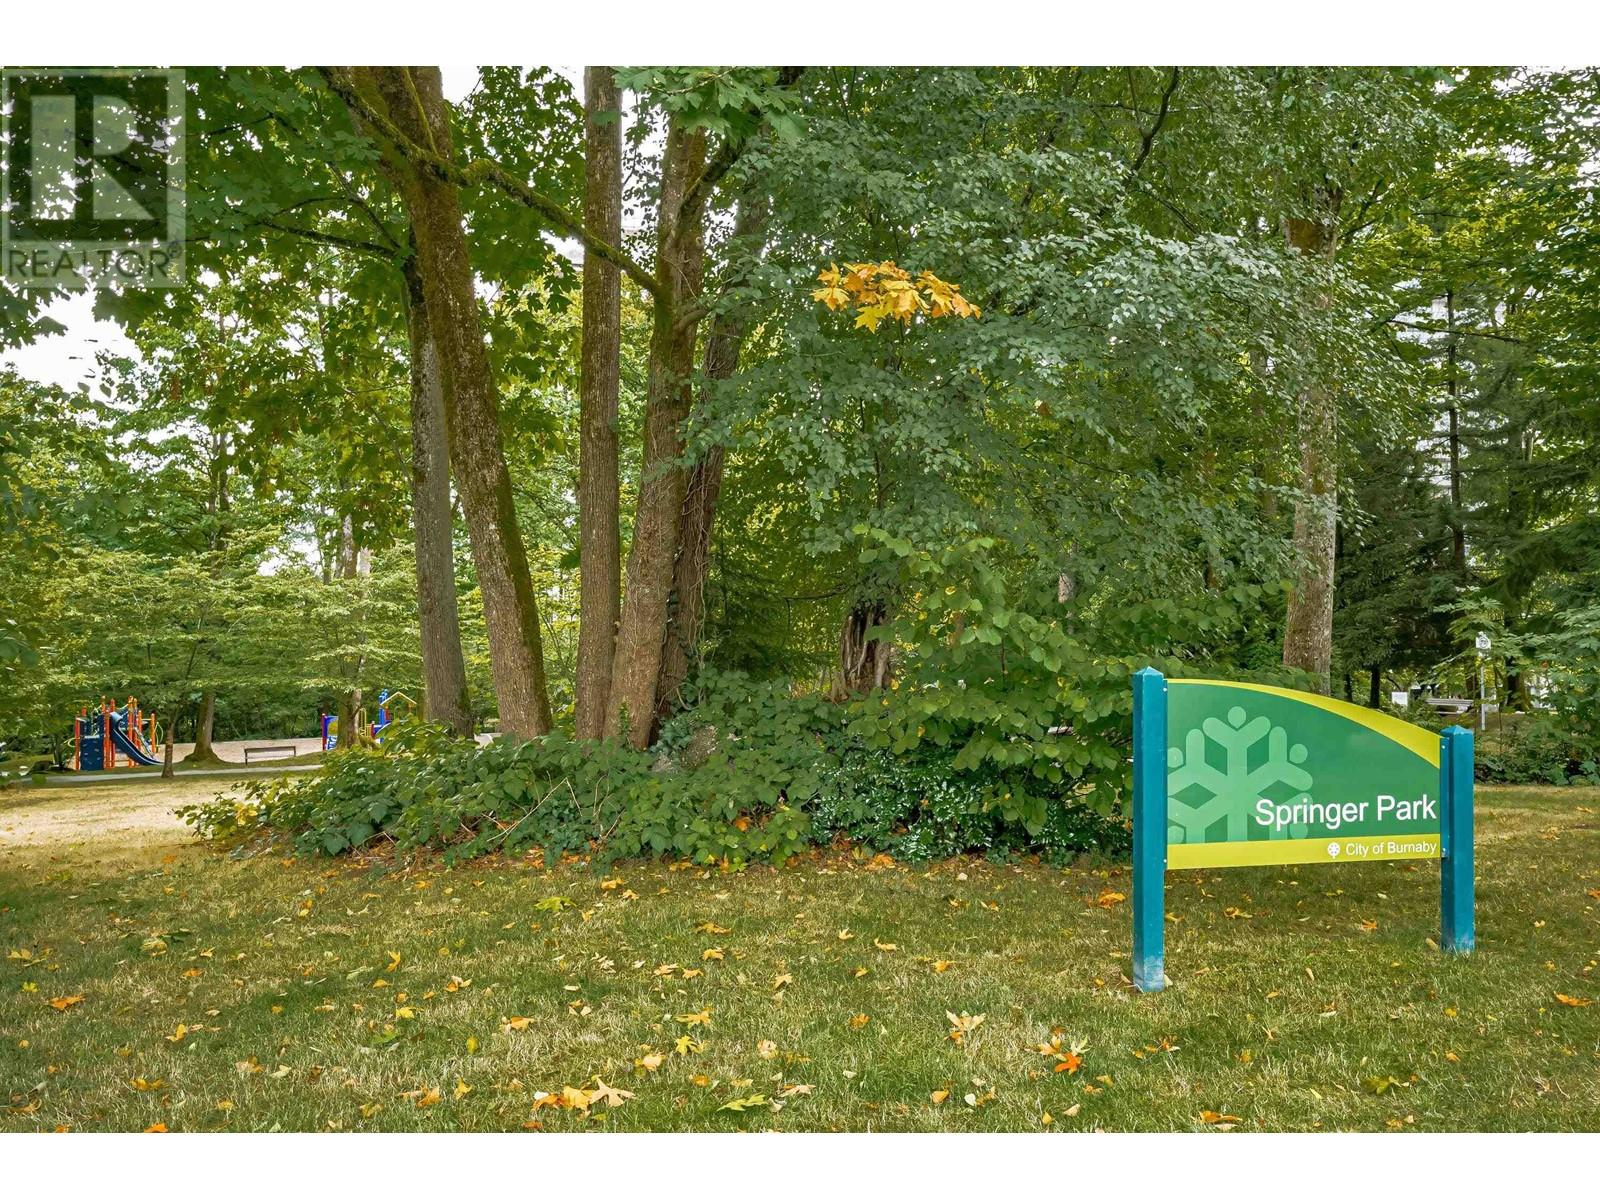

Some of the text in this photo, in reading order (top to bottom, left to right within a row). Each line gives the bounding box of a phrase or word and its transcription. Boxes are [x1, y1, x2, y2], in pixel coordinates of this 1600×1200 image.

[1255, 794, 1437, 831] Springer Park
[1345, 841, 1437, 858] City of Burnaby
